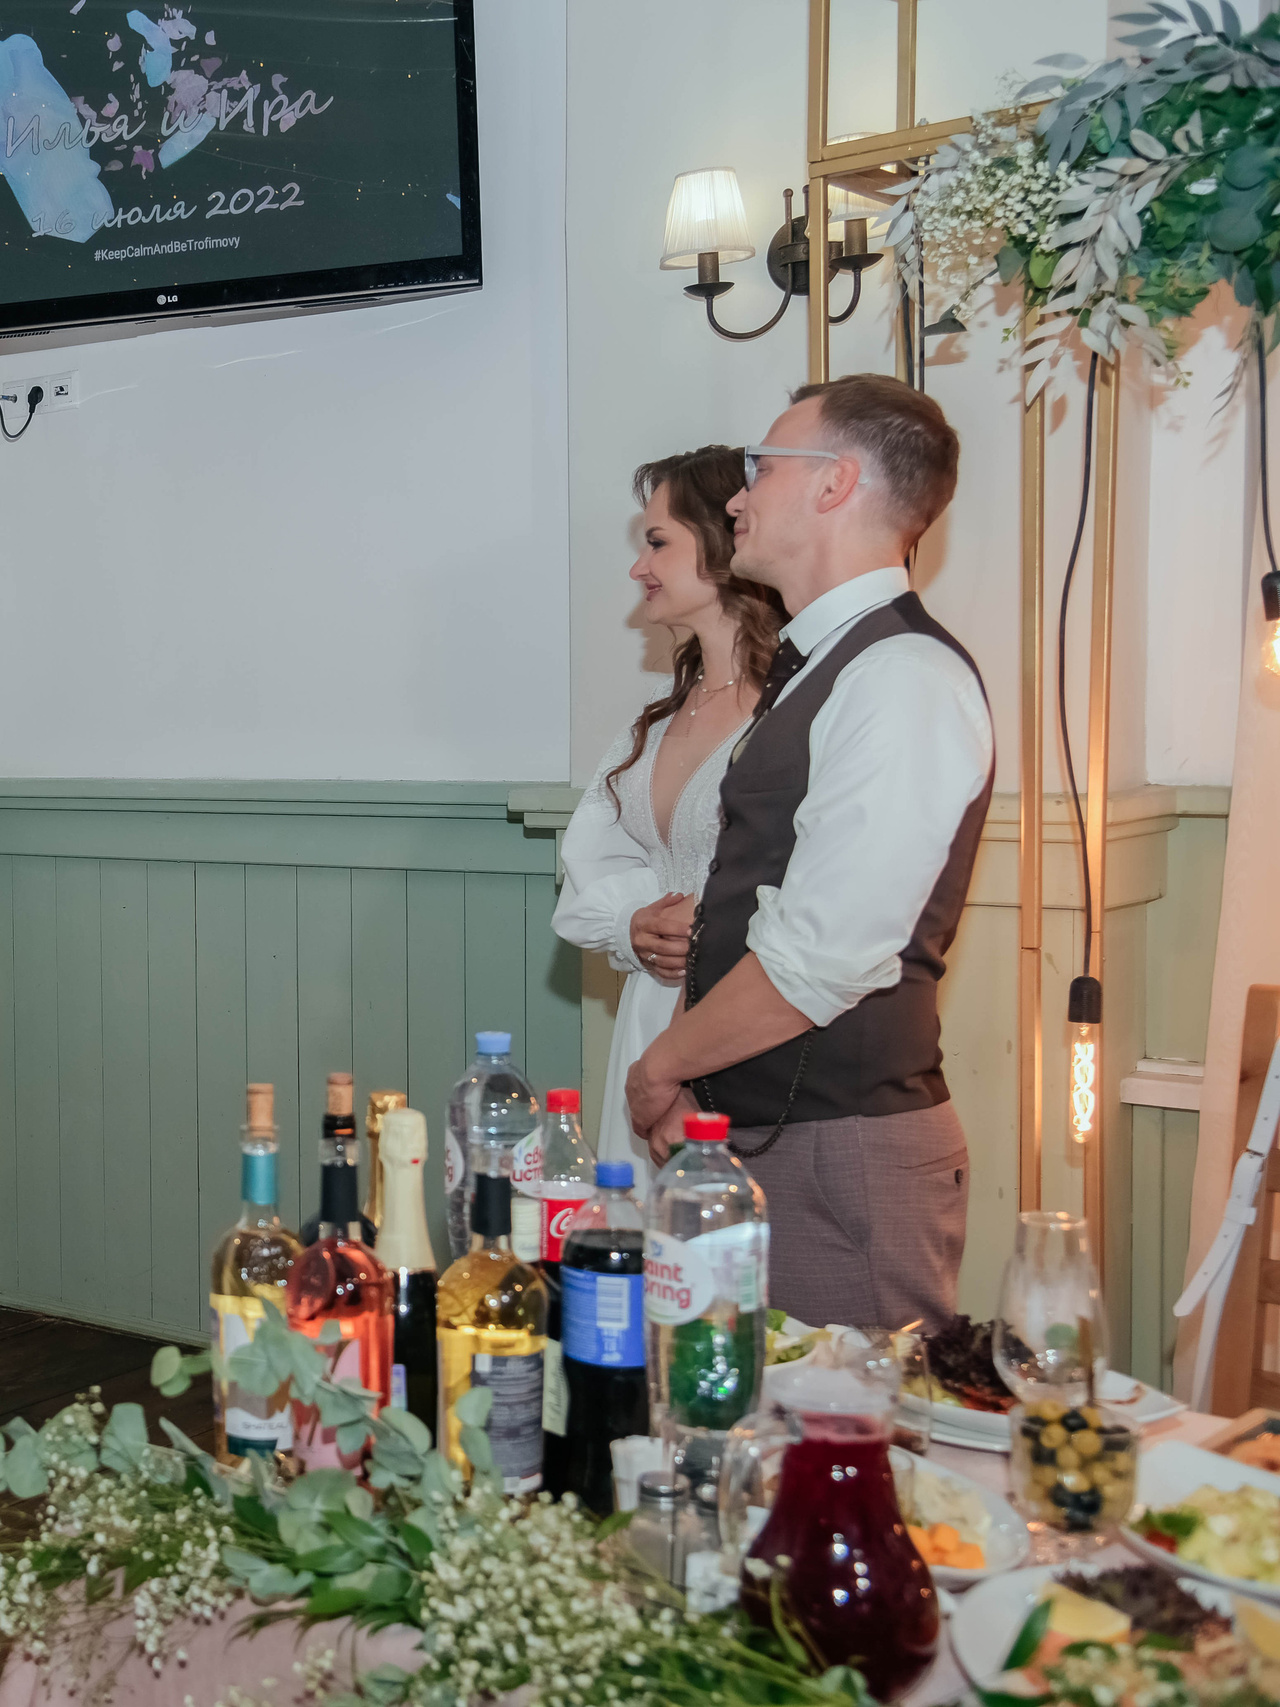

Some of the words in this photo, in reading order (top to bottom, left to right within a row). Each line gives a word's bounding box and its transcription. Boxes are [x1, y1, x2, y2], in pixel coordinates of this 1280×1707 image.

[6, 114, 147, 158] Илья
[160, 110, 204, 137] и
[218, 87, 334, 137] Ира
[90, 200, 197, 231] июля
[205, 182, 305, 219] 2022
[93, 236, 241, 262] #KeepCalmAndBeTrofimovy
[644, 1259, 683, 1283] aint
